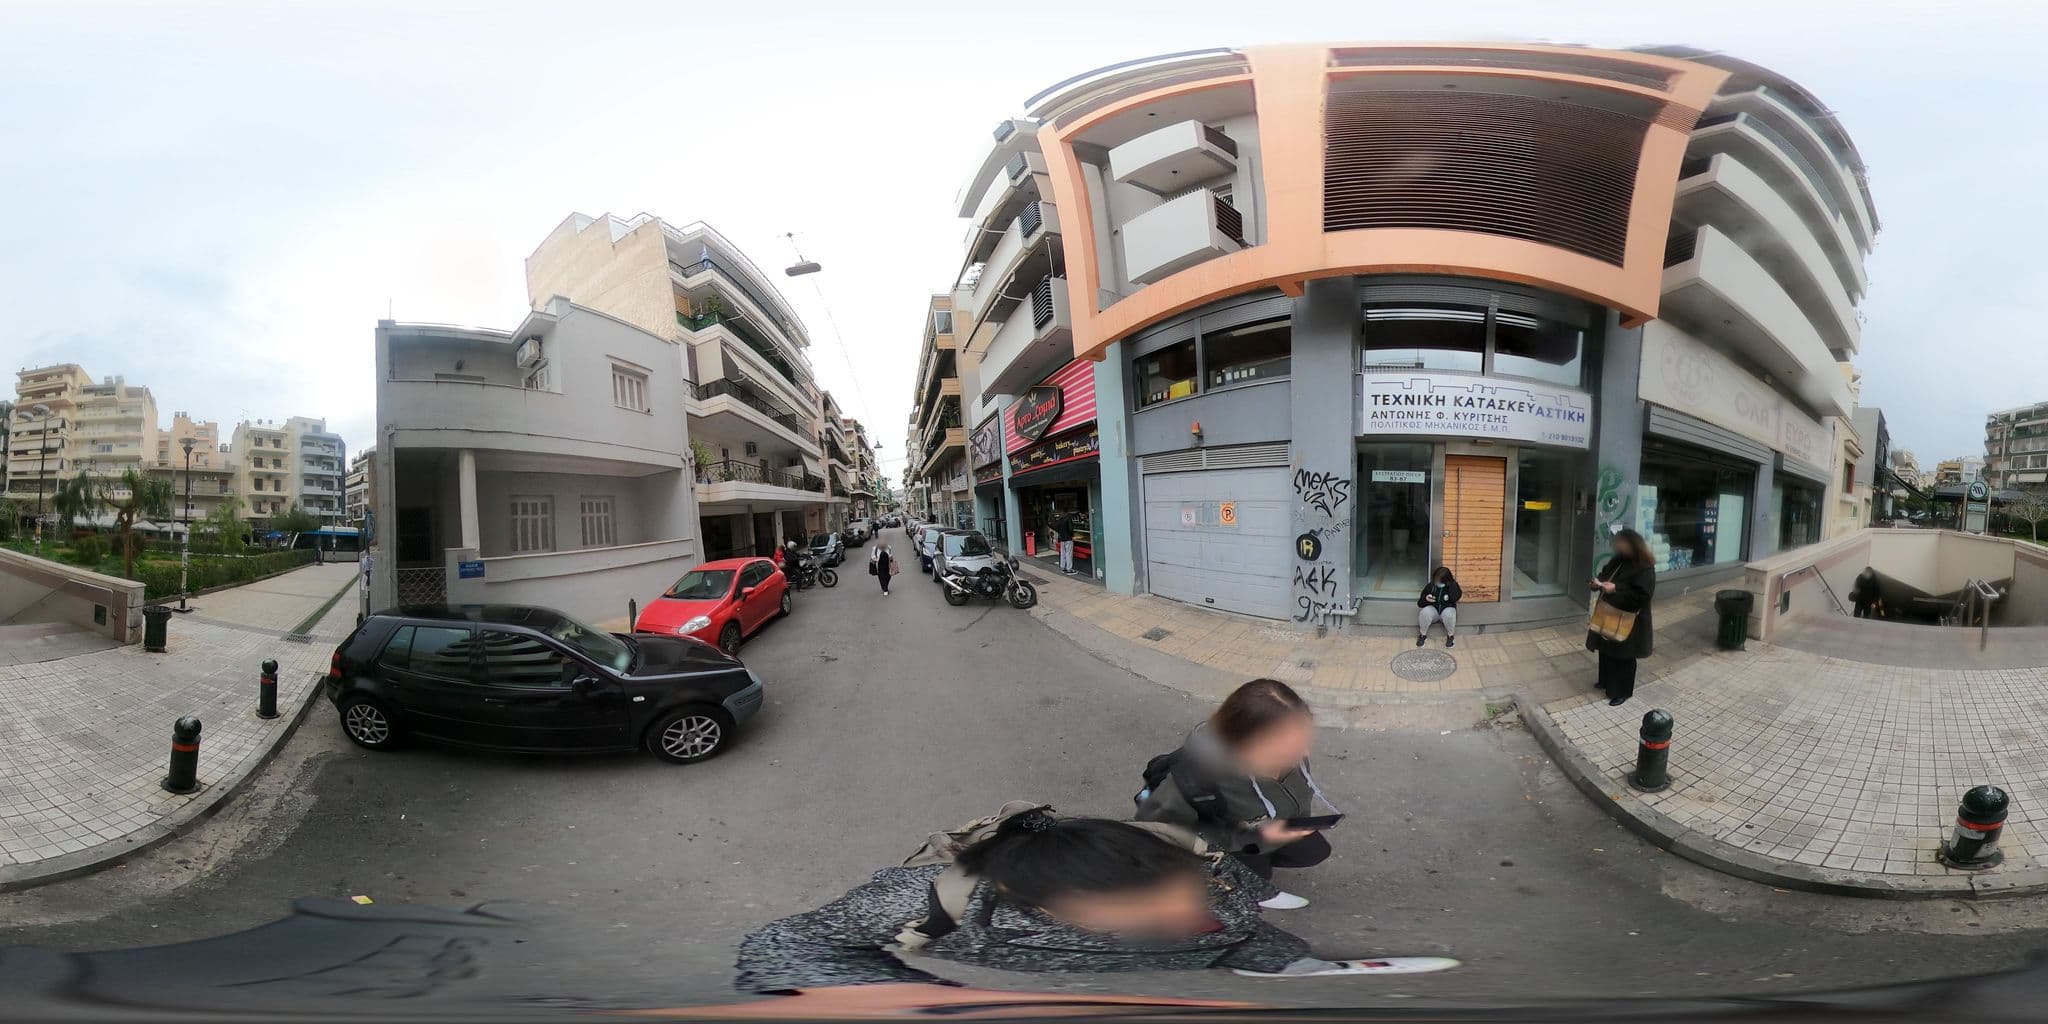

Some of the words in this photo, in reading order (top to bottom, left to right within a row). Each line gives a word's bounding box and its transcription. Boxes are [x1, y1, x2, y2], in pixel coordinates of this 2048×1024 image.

[1371, 394, 1446, 406] ΤΕΧΝΙΚΗ
[1453, 395, 1585, 423] ΚΑΤΑΣΚΕΥΑΣΤΙΚΗ
[1371, 410, 1431, 420] ΑΝΤΩΝΗΣ
[1454, 412, 1508, 424] ΚΥΡΙΤΣΗΣ
[1371, 421, 1422, 429] ΠΟΛΙΤΙΚΟΣ
[1425, 422, 1480, 431] ΜΗΧΑΝΙΚΟΣ
